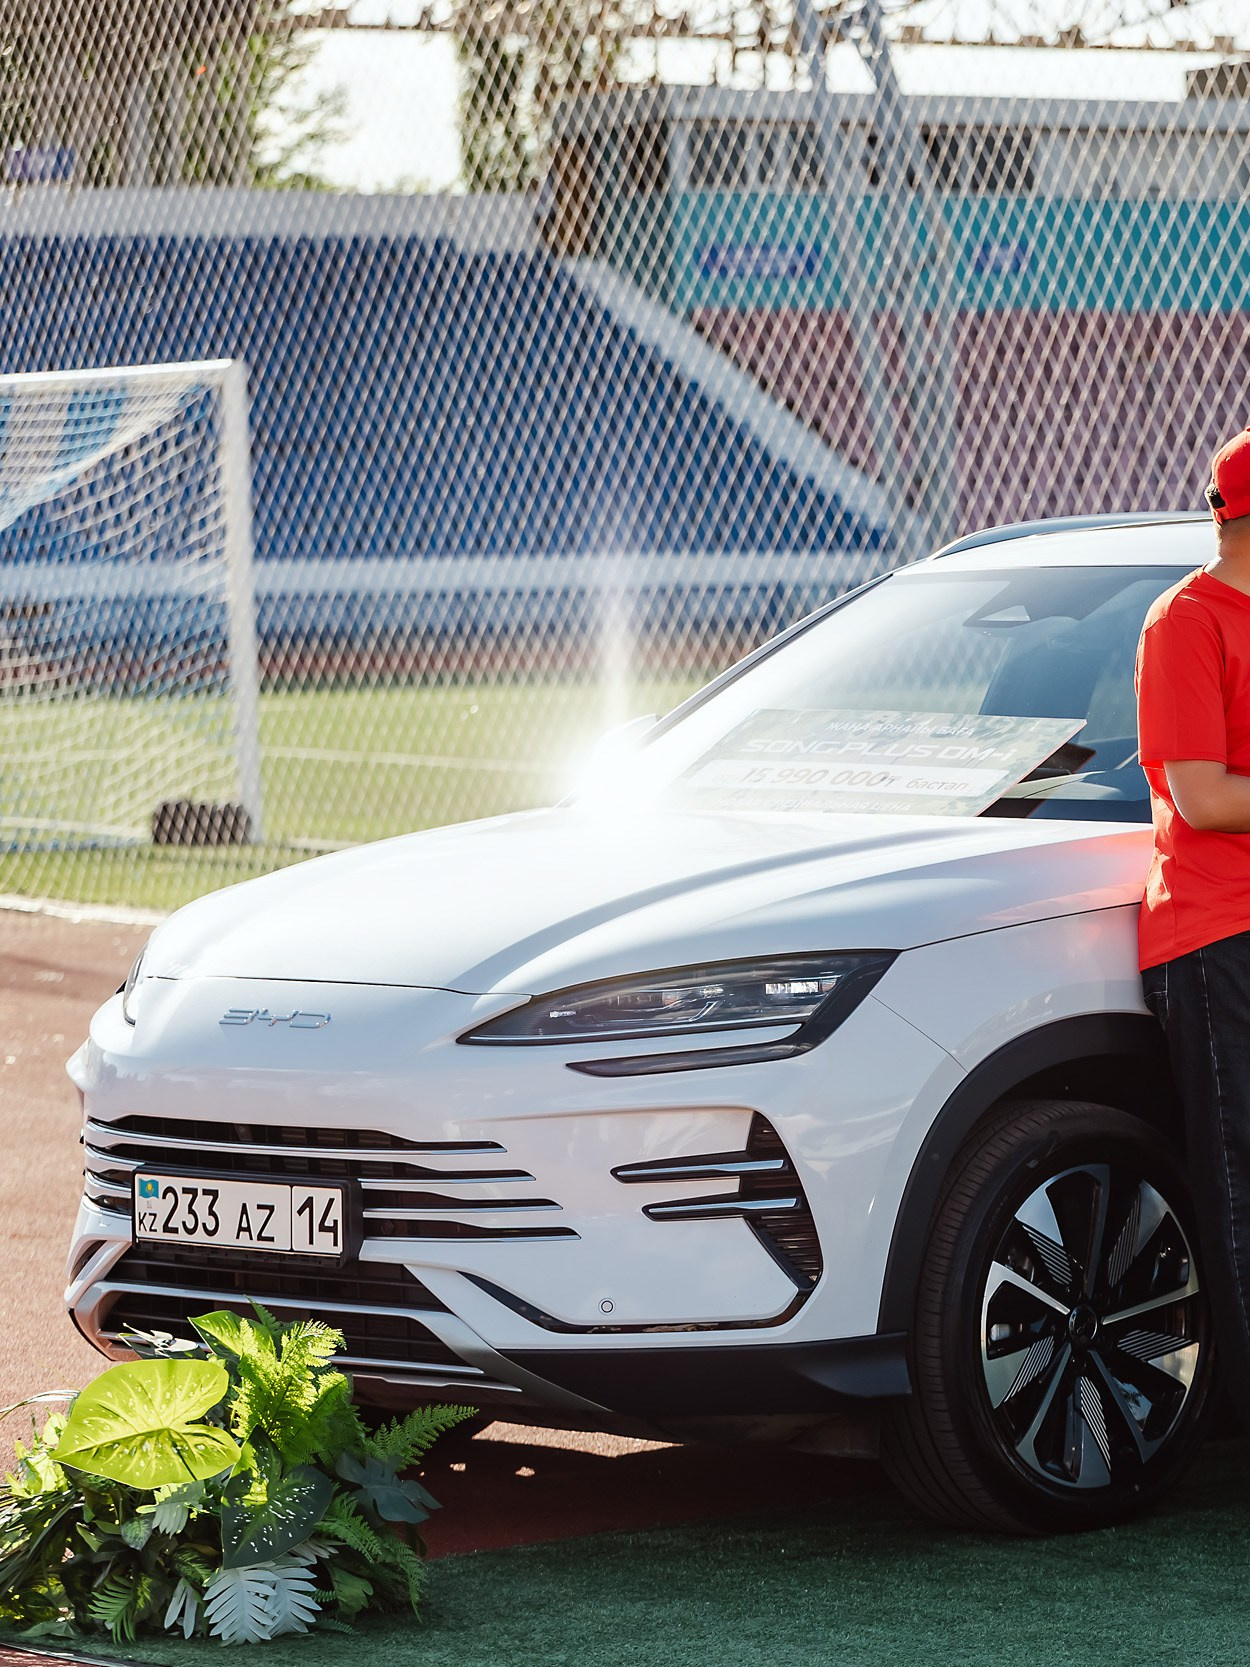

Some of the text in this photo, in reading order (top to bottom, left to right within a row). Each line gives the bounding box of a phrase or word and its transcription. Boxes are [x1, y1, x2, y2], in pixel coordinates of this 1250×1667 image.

[741, 739, 1018, 761] SONG PLUS DM-i
[740, 767, 775, 783] 15
[771, 768, 829, 785] 990
[906, 778, 969, 791] бастап
[872, 801, 913, 812] ЦЕНА
[219, 1007, 331, 1029] BYD
[138, 1212, 158, 1233] KZ
[162, 1186, 339, 1247] 233 AZ 14
